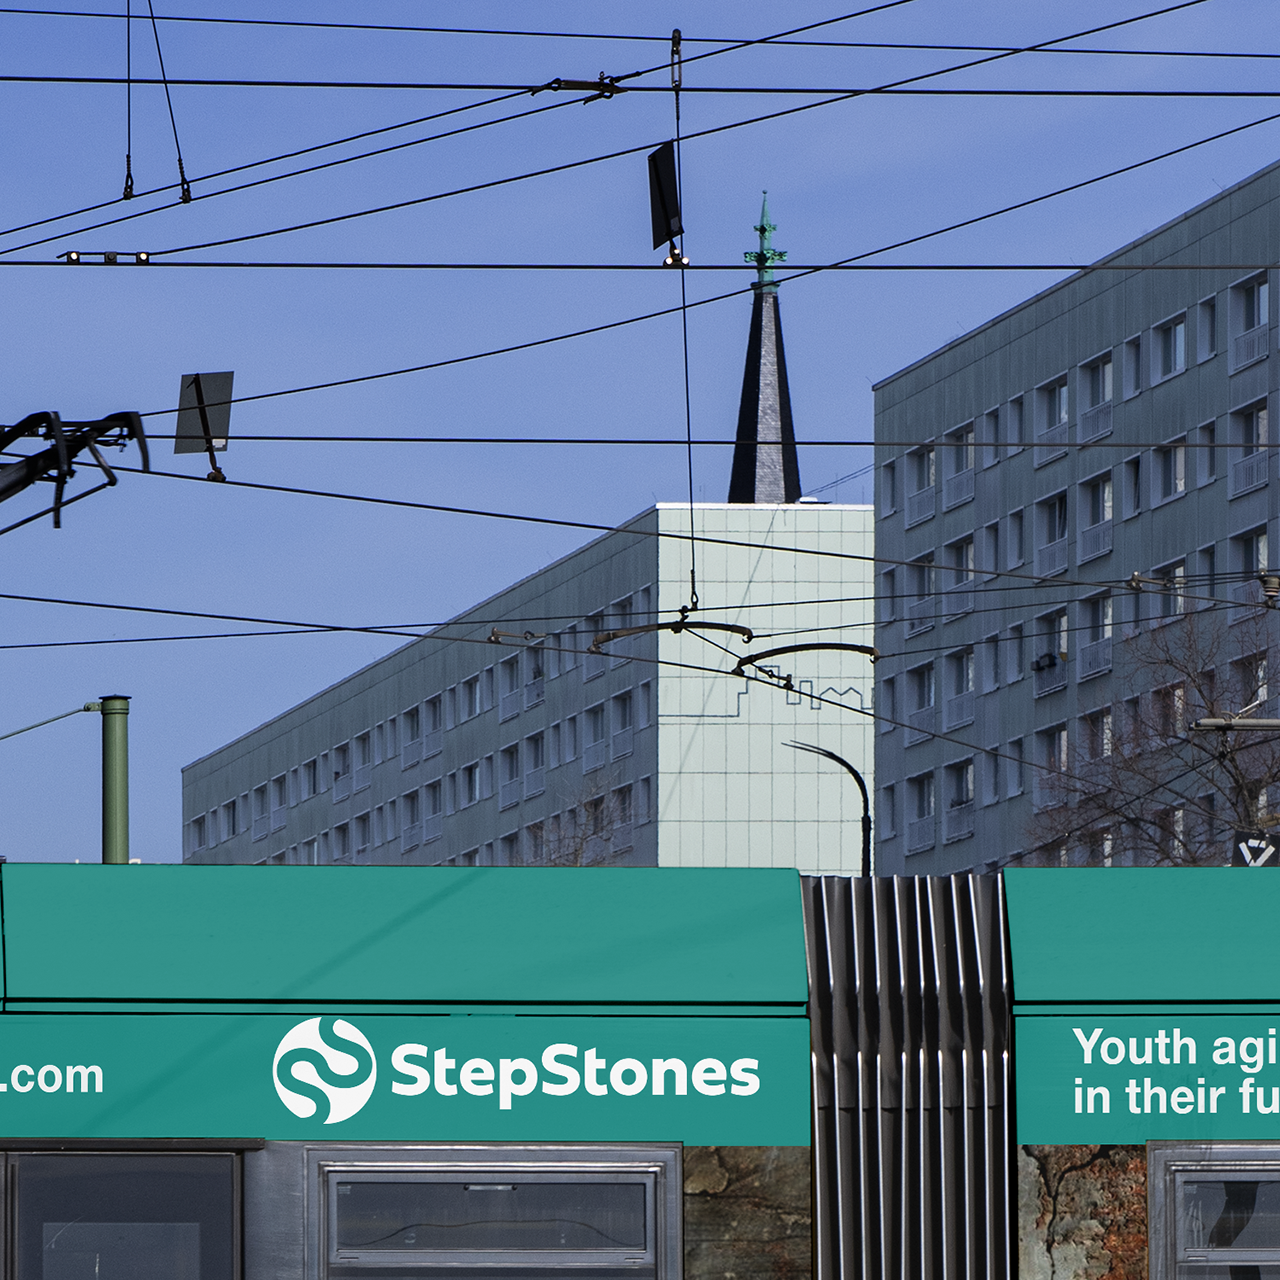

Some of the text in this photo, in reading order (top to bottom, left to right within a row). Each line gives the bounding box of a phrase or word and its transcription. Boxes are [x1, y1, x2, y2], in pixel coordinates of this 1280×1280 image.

[1073, 1027, 1196, 1065] Youth
[391, 1043, 760, 1110] StepStones
[1074, 1077, 1110, 1114] in
[1124, 1077, 1225, 1115] their
